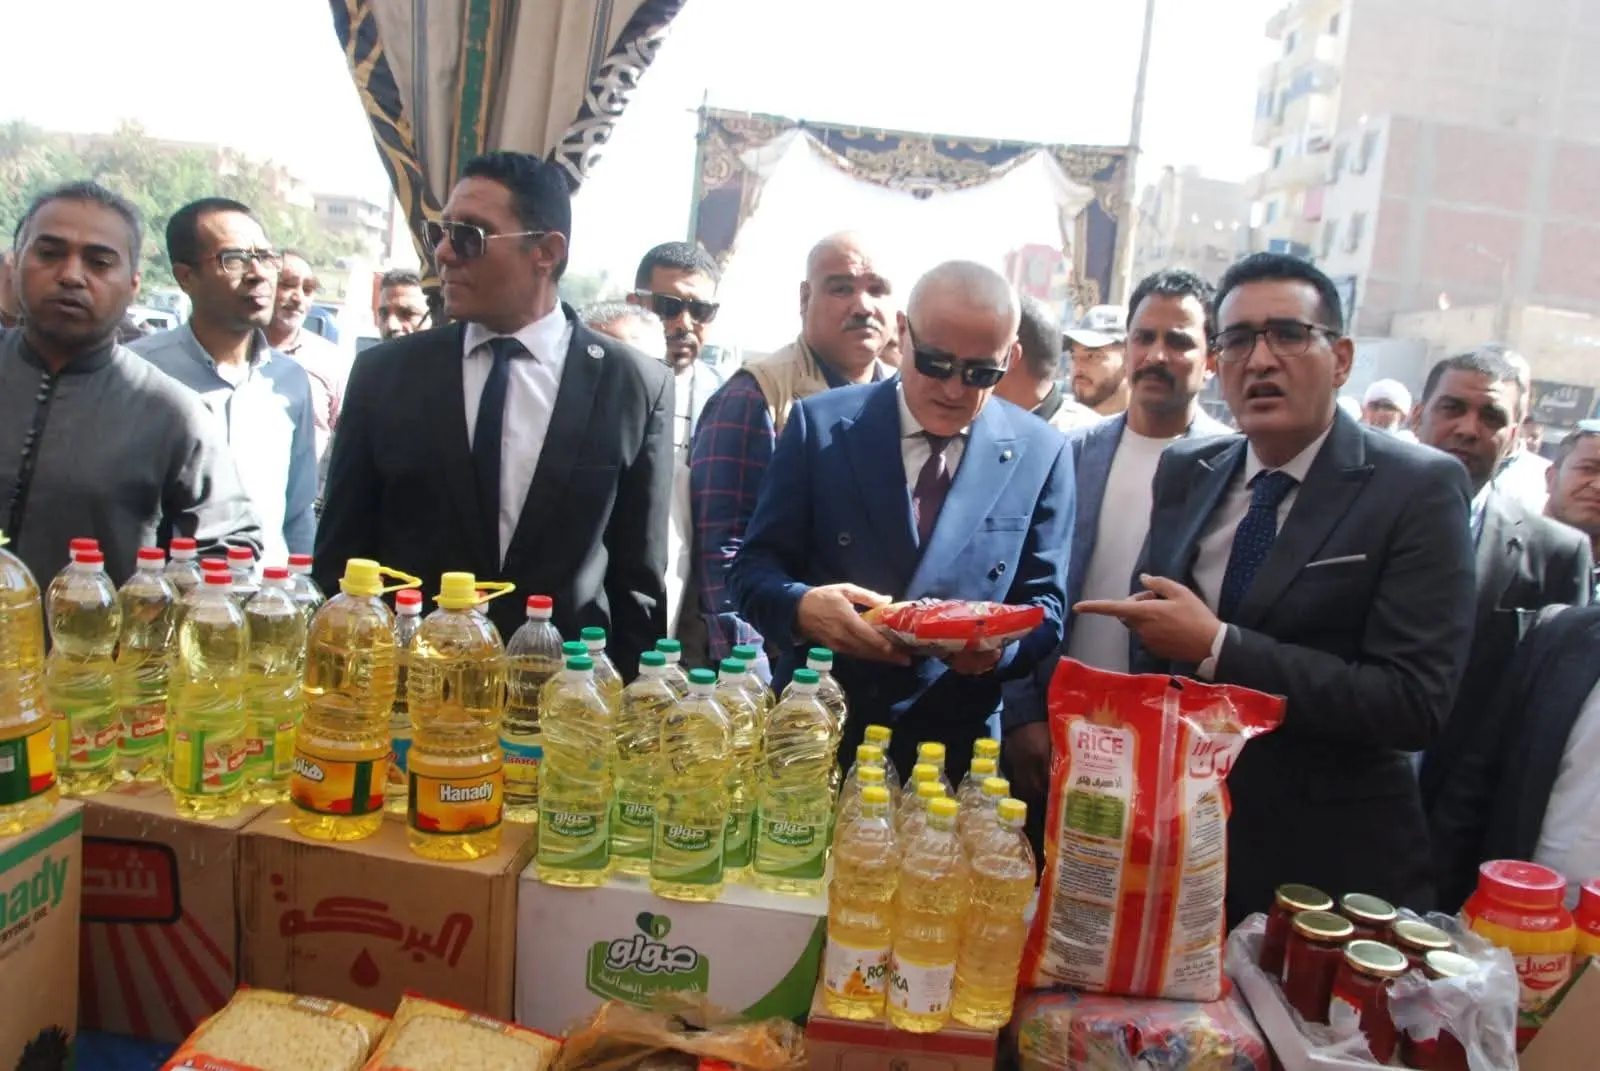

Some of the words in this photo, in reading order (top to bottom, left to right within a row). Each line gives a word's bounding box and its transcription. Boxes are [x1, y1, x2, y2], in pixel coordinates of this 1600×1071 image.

[1077, 731, 1124, 754] RICE
[440, 781, 493, 801] Hanady
[668, 824, 705, 839] صولو
[774, 820, 810, 834] صولو
[269, 873, 474, 969] البركة
[604, 934, 698, 974] صولو
[890, 969, 909, 993] OKA
